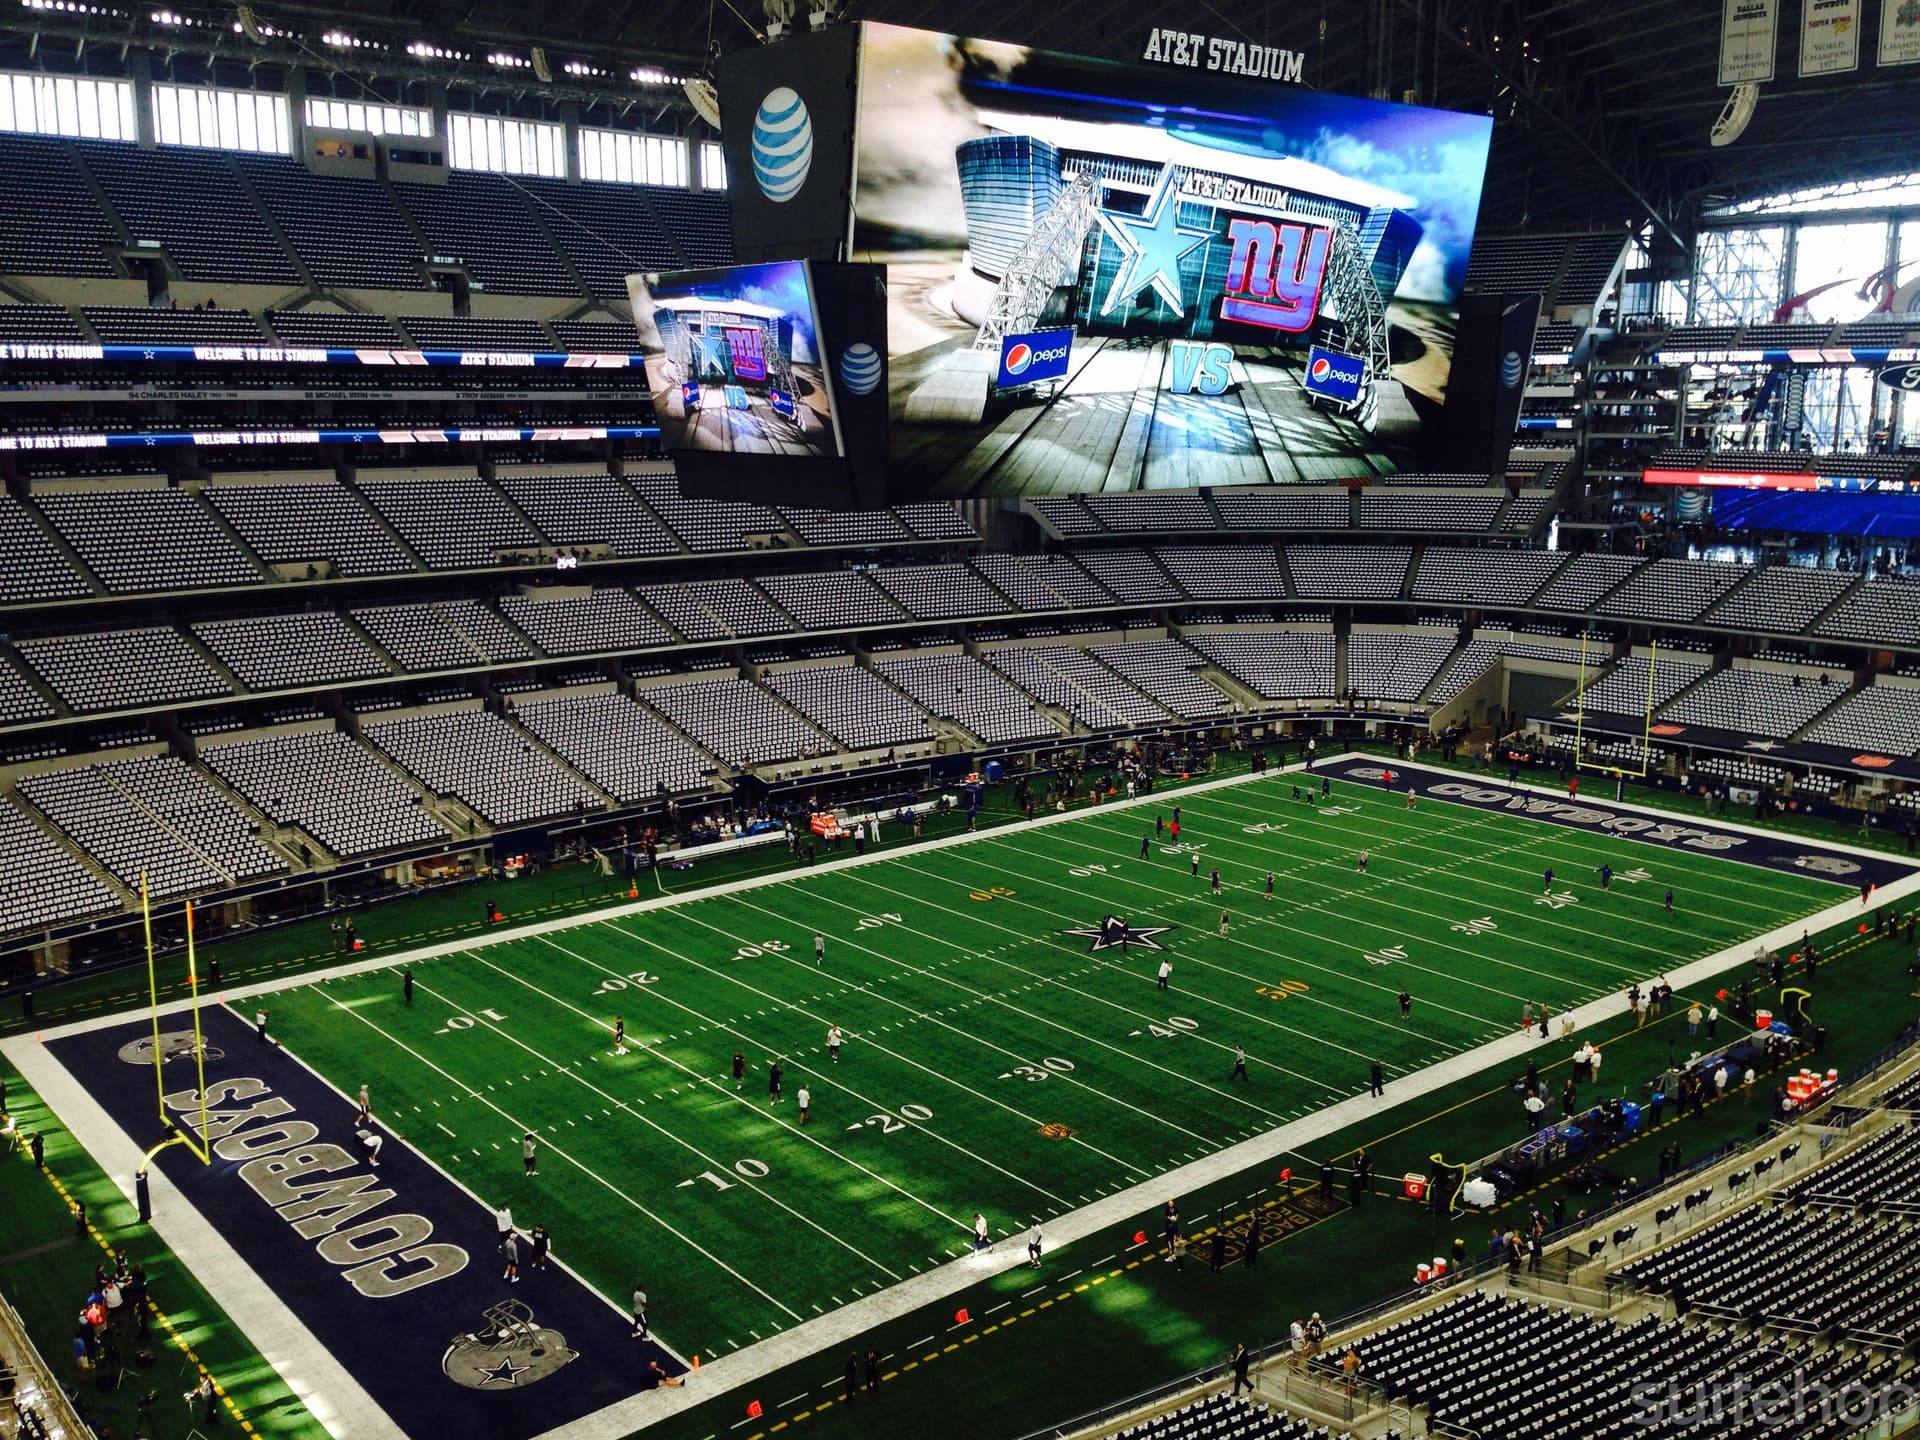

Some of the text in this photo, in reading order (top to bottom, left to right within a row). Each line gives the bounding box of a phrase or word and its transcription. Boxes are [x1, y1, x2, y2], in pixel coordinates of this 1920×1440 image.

[1143, 28, 1305, 83] AT&T STADIUM
[1182, 171, 1289, 211] AT&T STADIUM
[10, 346, 25, 358] TO
[27, 346, 54, 358] AT&T
[56, 346, 103, 359] STADIUM
[194, 347, 244, 360] WELCOME
[245, 347, 259, 360] TO
[460, 353, 535, 366] AT&T STADIUM
[1032, 347, 1067, 366] pepsi
[1659, 352, 1696, 362] WELCOME
[1329, 367, 1359, 386] pepsi
[140, 391, 180, 399] CHARLES
[181, 391, 208, 399] HALEY
[20, 438, 33, 449] TO
[35, 437, 60, 449] AT&T
[62, 435, 107, 448] STADIUM
[193, 431, 320, 445] WELCOME TO AT&T STADIUM
[1427, 783, 1748, 850] COWBOYS
[1068, 863, 1108, 877] 40
[969, 887, 1016, 901] 50
[859, 912, 904, 928] 40
[1450, 918, 1498, 935] 30
[737, 940, 791, 961] 30
[1363, 946, 1409, 965] 40
[602, 971, 660, 993] 20
[1255, 980, 1310, 1000] 50
[446, 1008, 508, 1031] 10
[1148, 1016, 1199, 1037] 40
[1012, 1057, 1075, 1082] 30
[865, 1104, 934, 1134] 20
[695, 1159, 770, 1191] 10
[163, 1078, 470, 1298] COWBOYS
[1409, 1184, 1419, 1193] G
